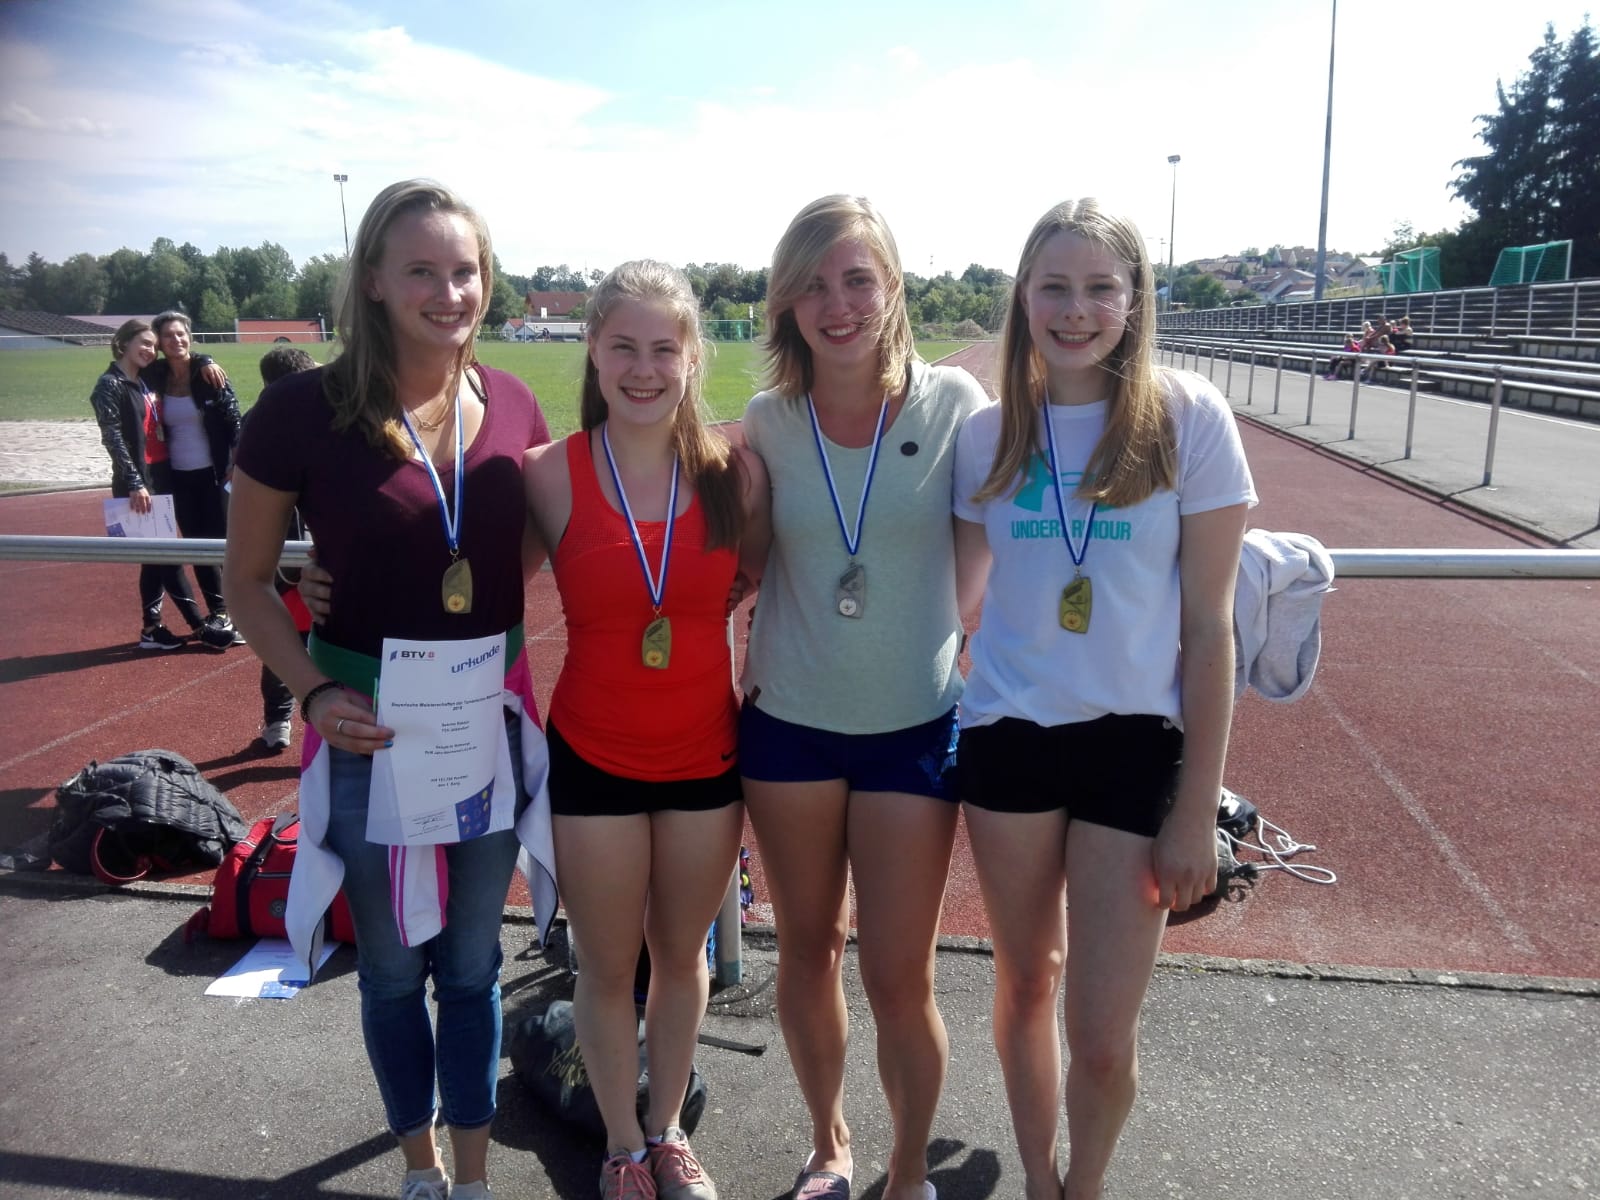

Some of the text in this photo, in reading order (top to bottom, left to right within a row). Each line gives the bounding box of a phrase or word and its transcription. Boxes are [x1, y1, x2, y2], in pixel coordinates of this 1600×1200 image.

[1011, 520, 1059, 539] UNDER
[401, 650, 425, 658] BTV
[450, 645, 501, 673] urkunde
